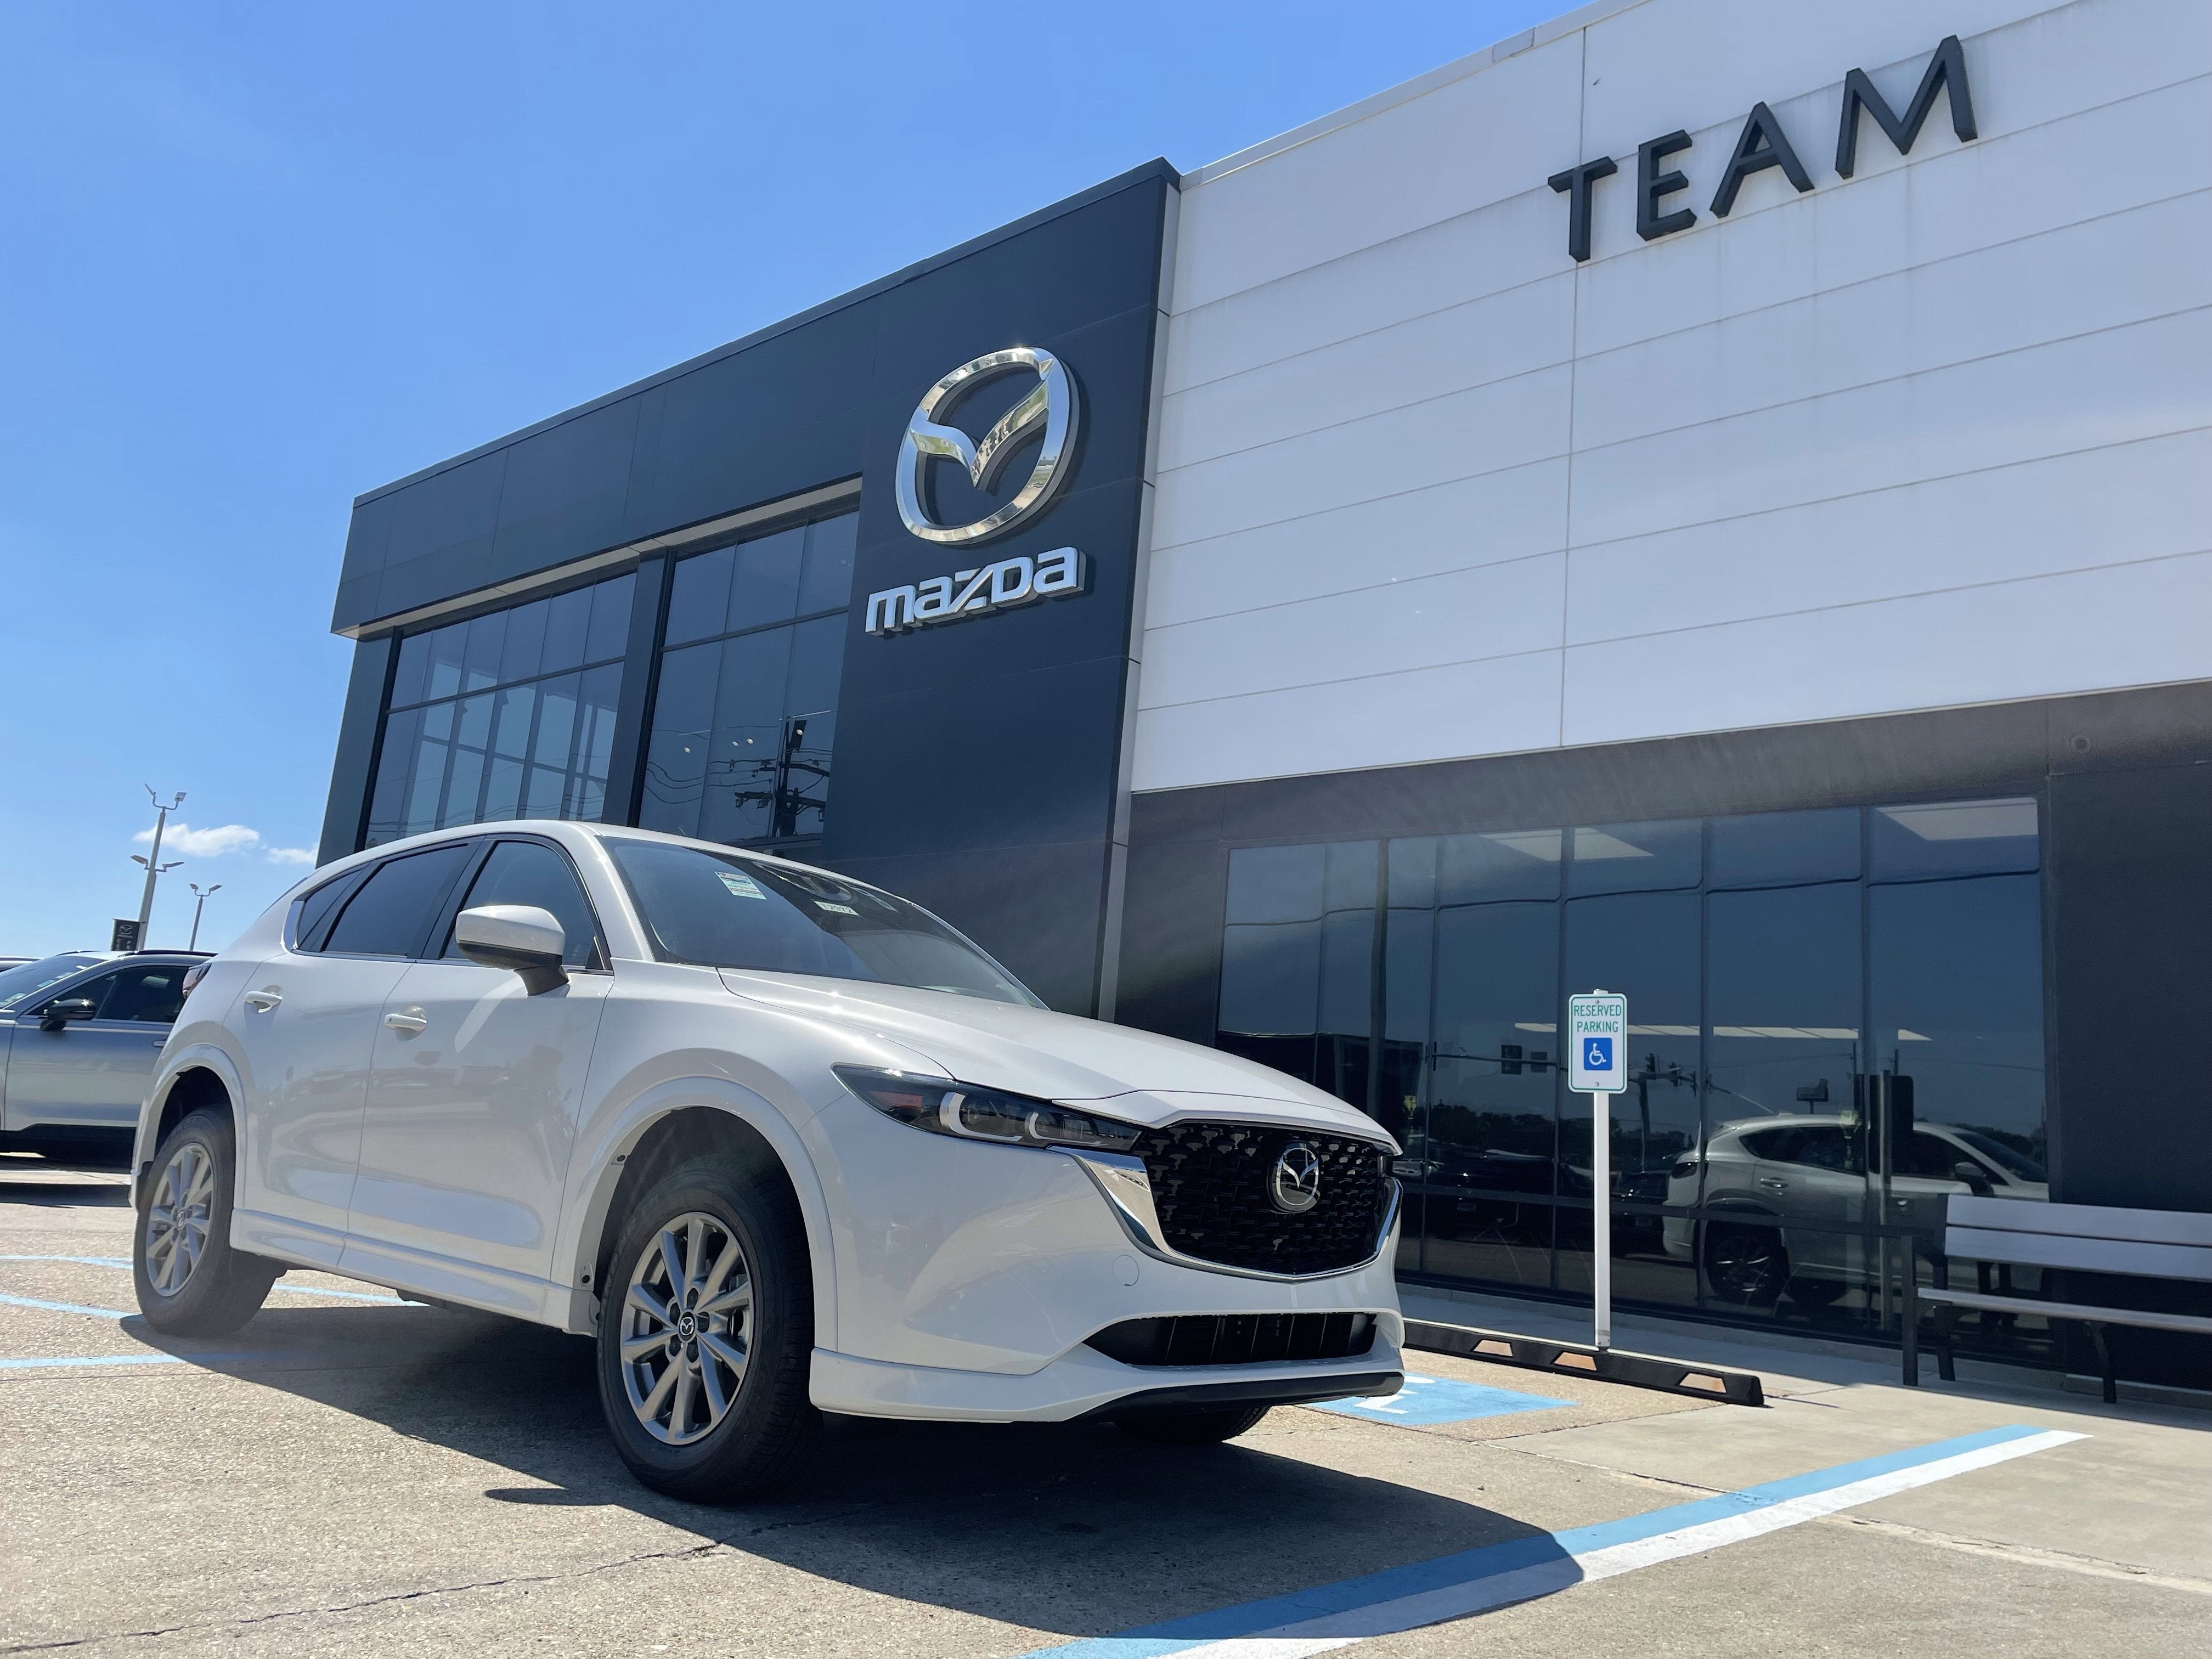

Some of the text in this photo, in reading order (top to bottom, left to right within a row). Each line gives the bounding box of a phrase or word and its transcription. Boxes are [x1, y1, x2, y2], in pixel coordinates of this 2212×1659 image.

[1548, 34, 1978, 262] TEAM
[865, 546, 1086, 635] mazda
[1573, 1005, 1622, 1017] RESERVED
[1577, 1021, 1618, 1033] PARKING
